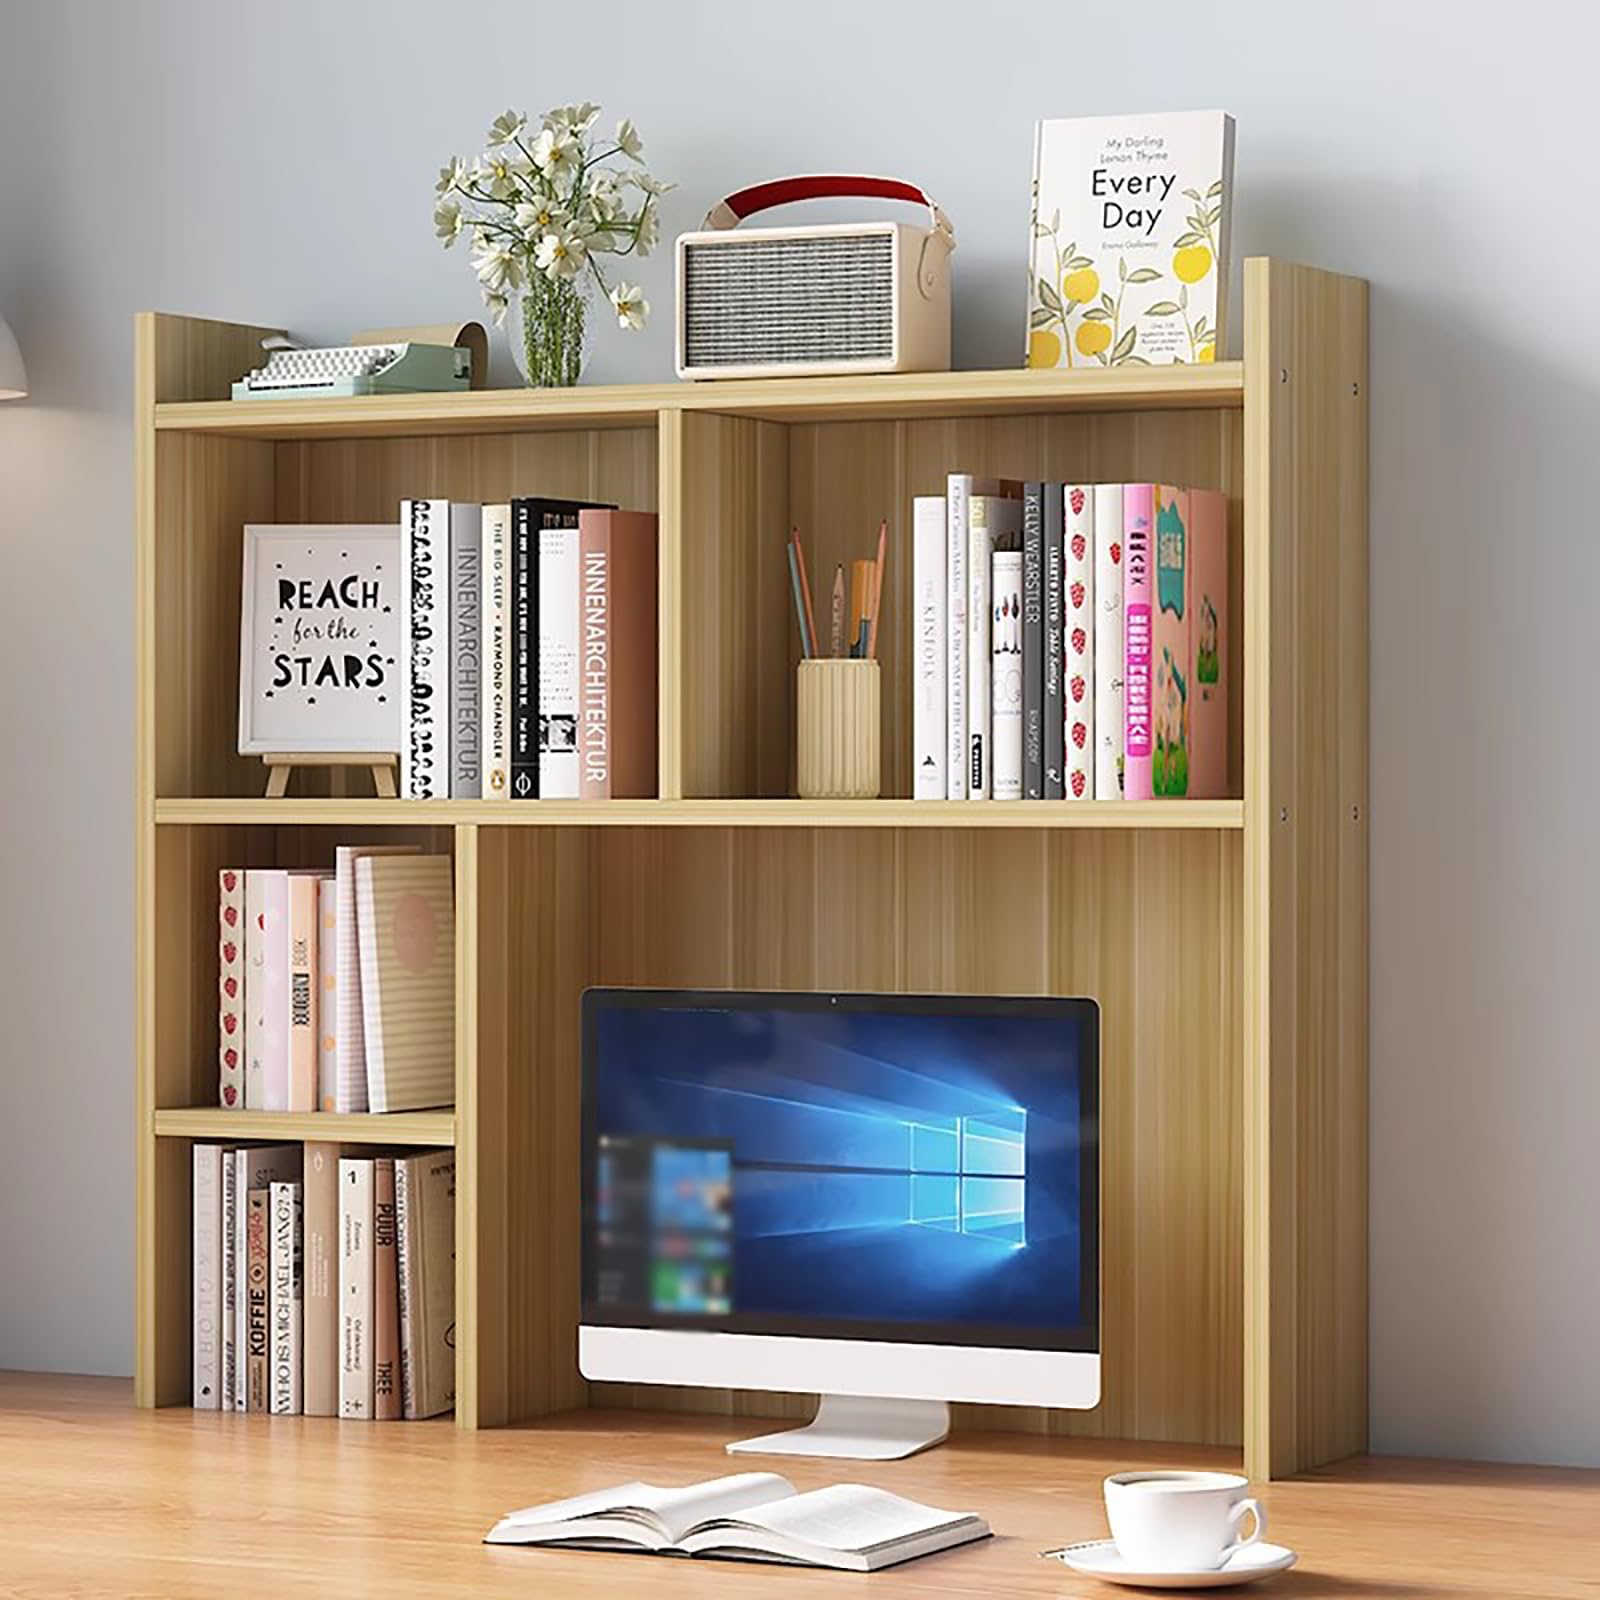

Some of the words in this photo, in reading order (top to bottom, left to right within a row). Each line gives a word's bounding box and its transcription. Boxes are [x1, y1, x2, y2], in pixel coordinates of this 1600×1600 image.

[1107, 139, 1122, 150] My
[1125, 136, 1164, 149] Darling
[1136, 150, 1168, 163] Thyme
[1092, 168, 1176, 201] Every
[1103, 202, 1162, 236] Day
[494, 522, 503, 544] THE
[1025, 496, 1040, 535] KELLY
[494, 549, 503, 570] BIG
[278, 575, 379, 611] REACH
[494, 575, 503, 608] SLEEP
[1025, 538, 1040, 623] WEARSTLER
[294, 617, 324, 644] for
[328, 616, 359, 639] the
[924, 607, 937, 680] KINFOLK
[273, 654, 385, 689] STARS
[458, 548, 478, 781] INNENARCHITEKTUR
[494, 626, 503, 690] RAYMOND
[585, 552, 606, 782] INNENARCHITEKTUR
[494, 694, 503, 759] CHANDLER
[377, 1202, 393, 1247] PUUR
[277, 1262, 290, 1343] MICHAEL
[251, 1289, 265, 1357] KOFFIE
[277, 1346, 290, 1363] IS
[277, 1365, 290, 1413] WHO
[377, 1361, 393, 1395] THEE
